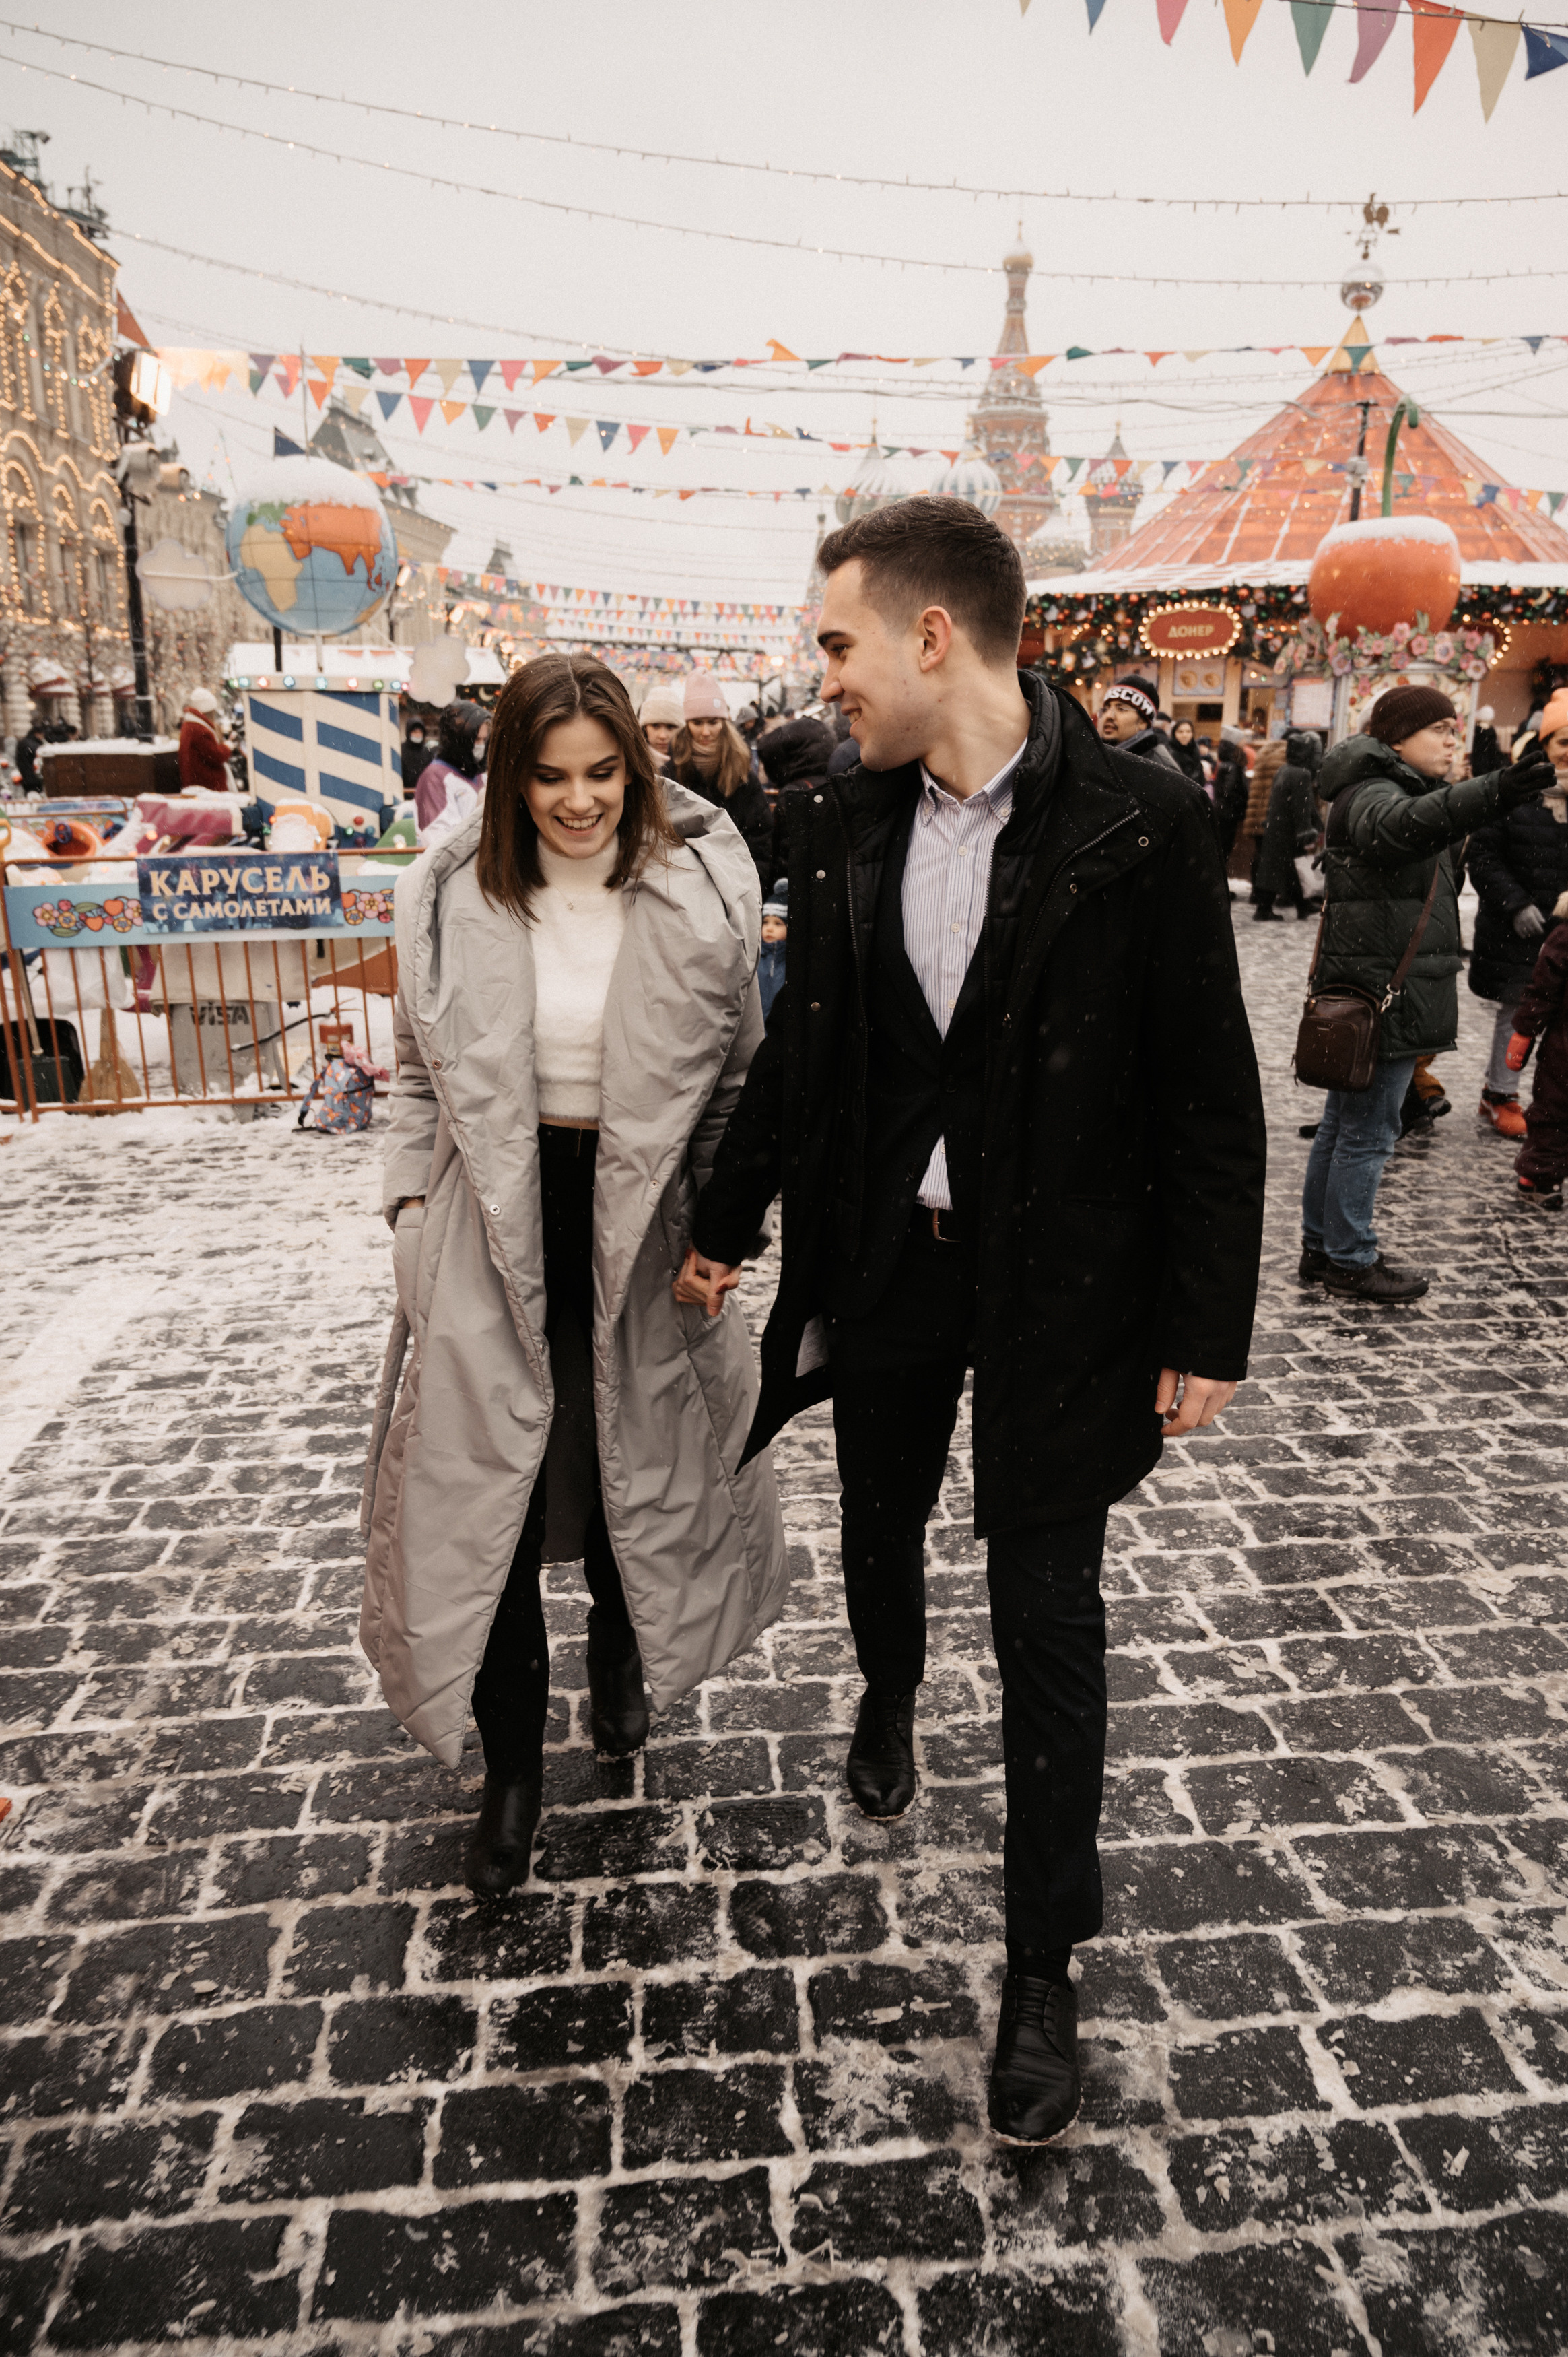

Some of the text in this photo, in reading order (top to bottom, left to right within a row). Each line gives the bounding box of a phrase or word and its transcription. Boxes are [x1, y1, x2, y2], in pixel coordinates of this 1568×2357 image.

[1168, 624, 1215, 638] ДОНЕР
[1105, 688, 1154, 715] SCOW
[149, 865, 331, 897] КАРУСЕЛЬ
[151, 897, 332, 921] С САМОЛЕТАМИ
